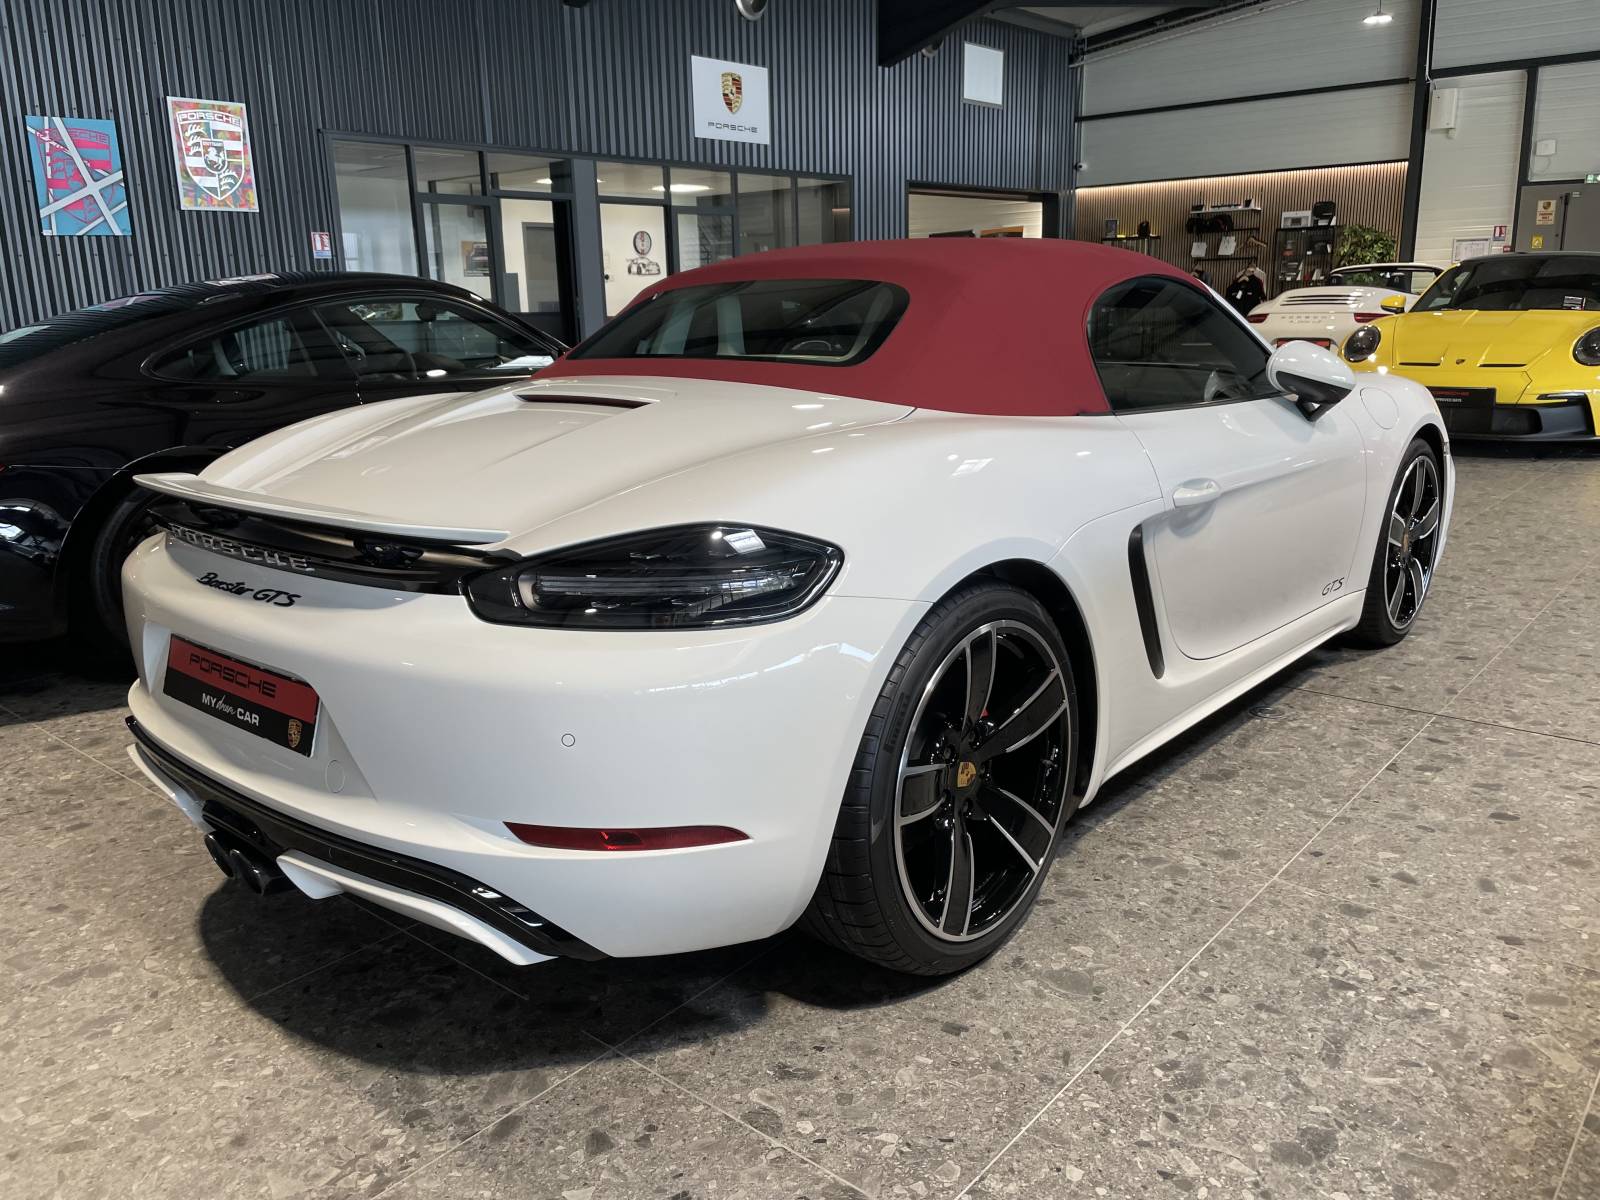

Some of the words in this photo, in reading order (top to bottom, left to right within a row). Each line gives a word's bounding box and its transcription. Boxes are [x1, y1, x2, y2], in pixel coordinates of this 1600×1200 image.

[178, 112, 241, 127] PORSCHE
[708, 121, 758, 133] PORSCHE
[168, 522, 314, 572] PORSCHE
[1322, 577, 1344, 596] GTS
[252, 588, 302, 607] GTS
[189, 653, 278, 699] PORSCHE
[202, 693, 217, 708] MY
[236, 707, 260, 727] CAR
